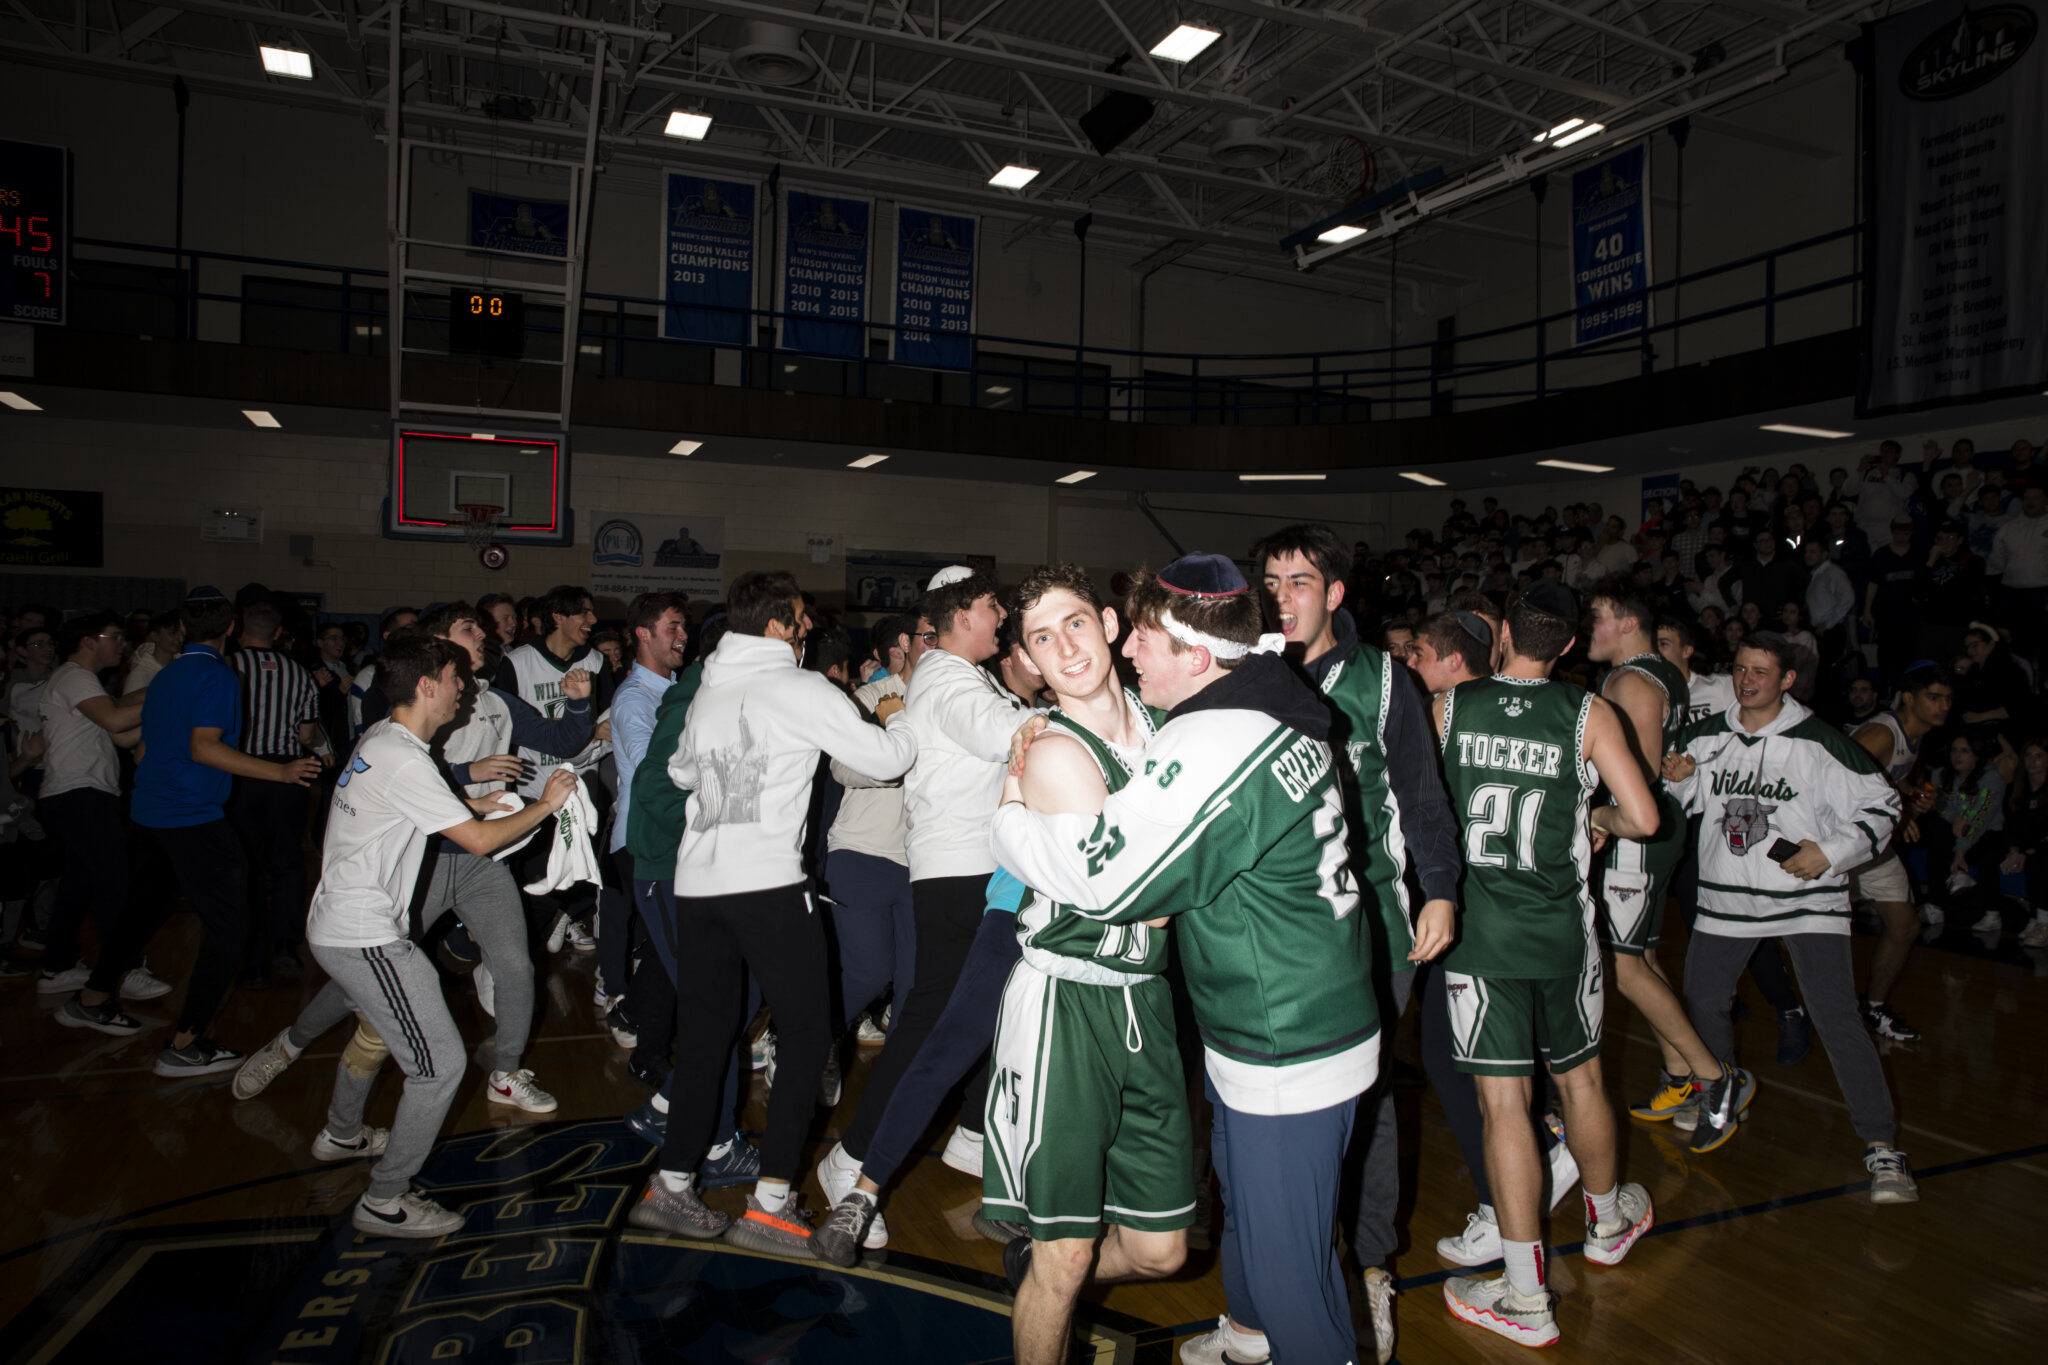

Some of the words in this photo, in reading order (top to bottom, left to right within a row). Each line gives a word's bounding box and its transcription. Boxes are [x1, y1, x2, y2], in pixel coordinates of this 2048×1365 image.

[1917, 40, 2016, 92] SKYLINE
[0, 214, 51, 251] 45
[672, 242, 713, 255] HUDSON
[715, 247, 749, 259] VALLEY
[1594, 232, 1624, 262] 40
[13, 254, 58, 270] FOULS
[671, 253, 749, 272] CHAMPIONS
[790, 255, 829, 269] HUDSON
[831, 261, 863, 273] VALLEY
[1576, 251, 1643, 284] CONSECUTIVE
[33, 271, 51, 299] 7
[673, 270, 704, 284] 2013
[788, 266, 864, 286] CHAMPIONS
[902, 271, 938, 284] HUDSON
[940, 277, 969, 288] VALLEY
[790, 283, 822, 297] 2010
[830, 288, 859, 301] 2013
[900, 281, 970, 301] CHAMPIONS
[1587, 270, 1633, 302] WINS
[13, 304, 58, 319] SCORE
[470, 295, 503, 316] 00
[791, 298, 821, 314] 2014
[829, 304, 859, 318] 2015
[902, 298, 932, 311] 2010
[941, 303, 965, 315] 2011
[1580, 299, 1643, 331] 1995-1999
[903, 314, 931, 327] 2012
[941, 319, 968, 331] 2013
[903, 330, 931, 343] 2014
[1643, 487, 1679, 499] SECTION
[24, 490, 73, 520] HEIGHTS
[38, 551, 70, 564] Grill
[534, 682, 567, 701] WIL
[1498, 697, 1532, 709] DRS
[1457, 732, 1562, 778] TOCKER
[1465, 782, 1546, 872] 21
